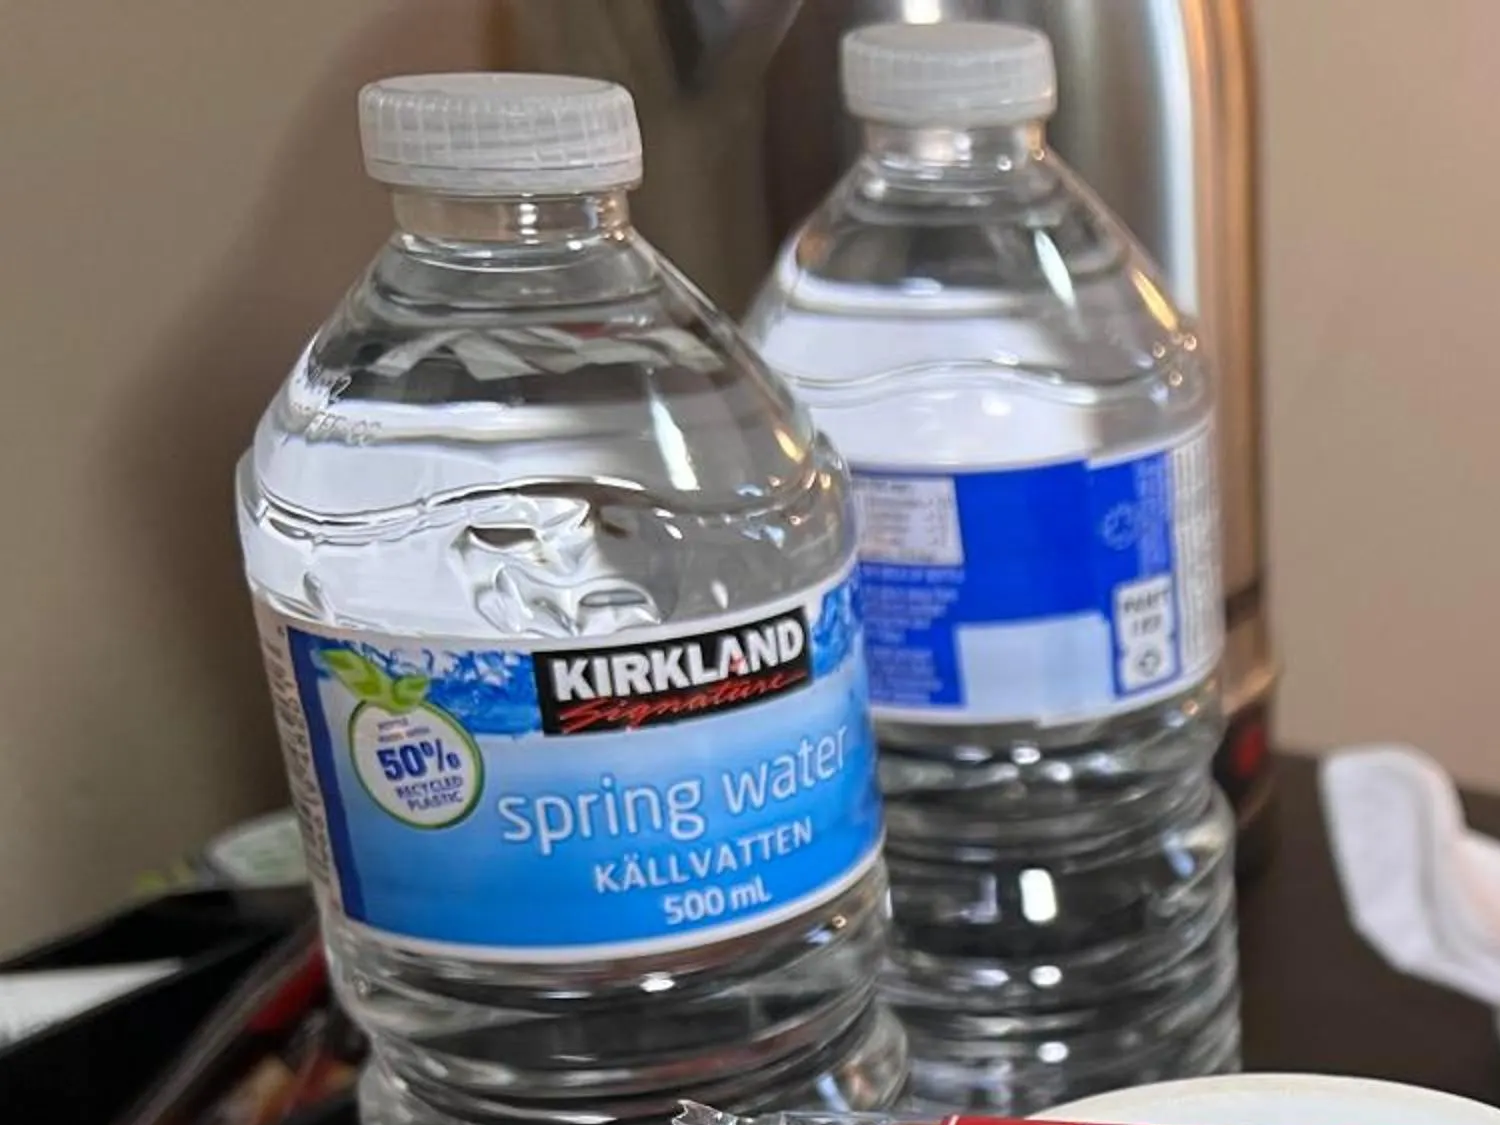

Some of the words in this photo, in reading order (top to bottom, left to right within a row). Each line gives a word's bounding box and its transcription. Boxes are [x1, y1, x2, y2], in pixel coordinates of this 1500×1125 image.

[552, 618, 804, 701] KIRKLAND
[559, 669, 807, 735] Signature
[376, 737, 462, 781] 50%
[395, 775, 464, 799] RECYCLED
[407, 791, 464, 811] PLASTIC
[498, 772, 706, 856] spring
[721, 725, 848, 815] water
[593, 816, 813, 895] KÄLLVATTEN
[663, 885, 725, 926] 500
